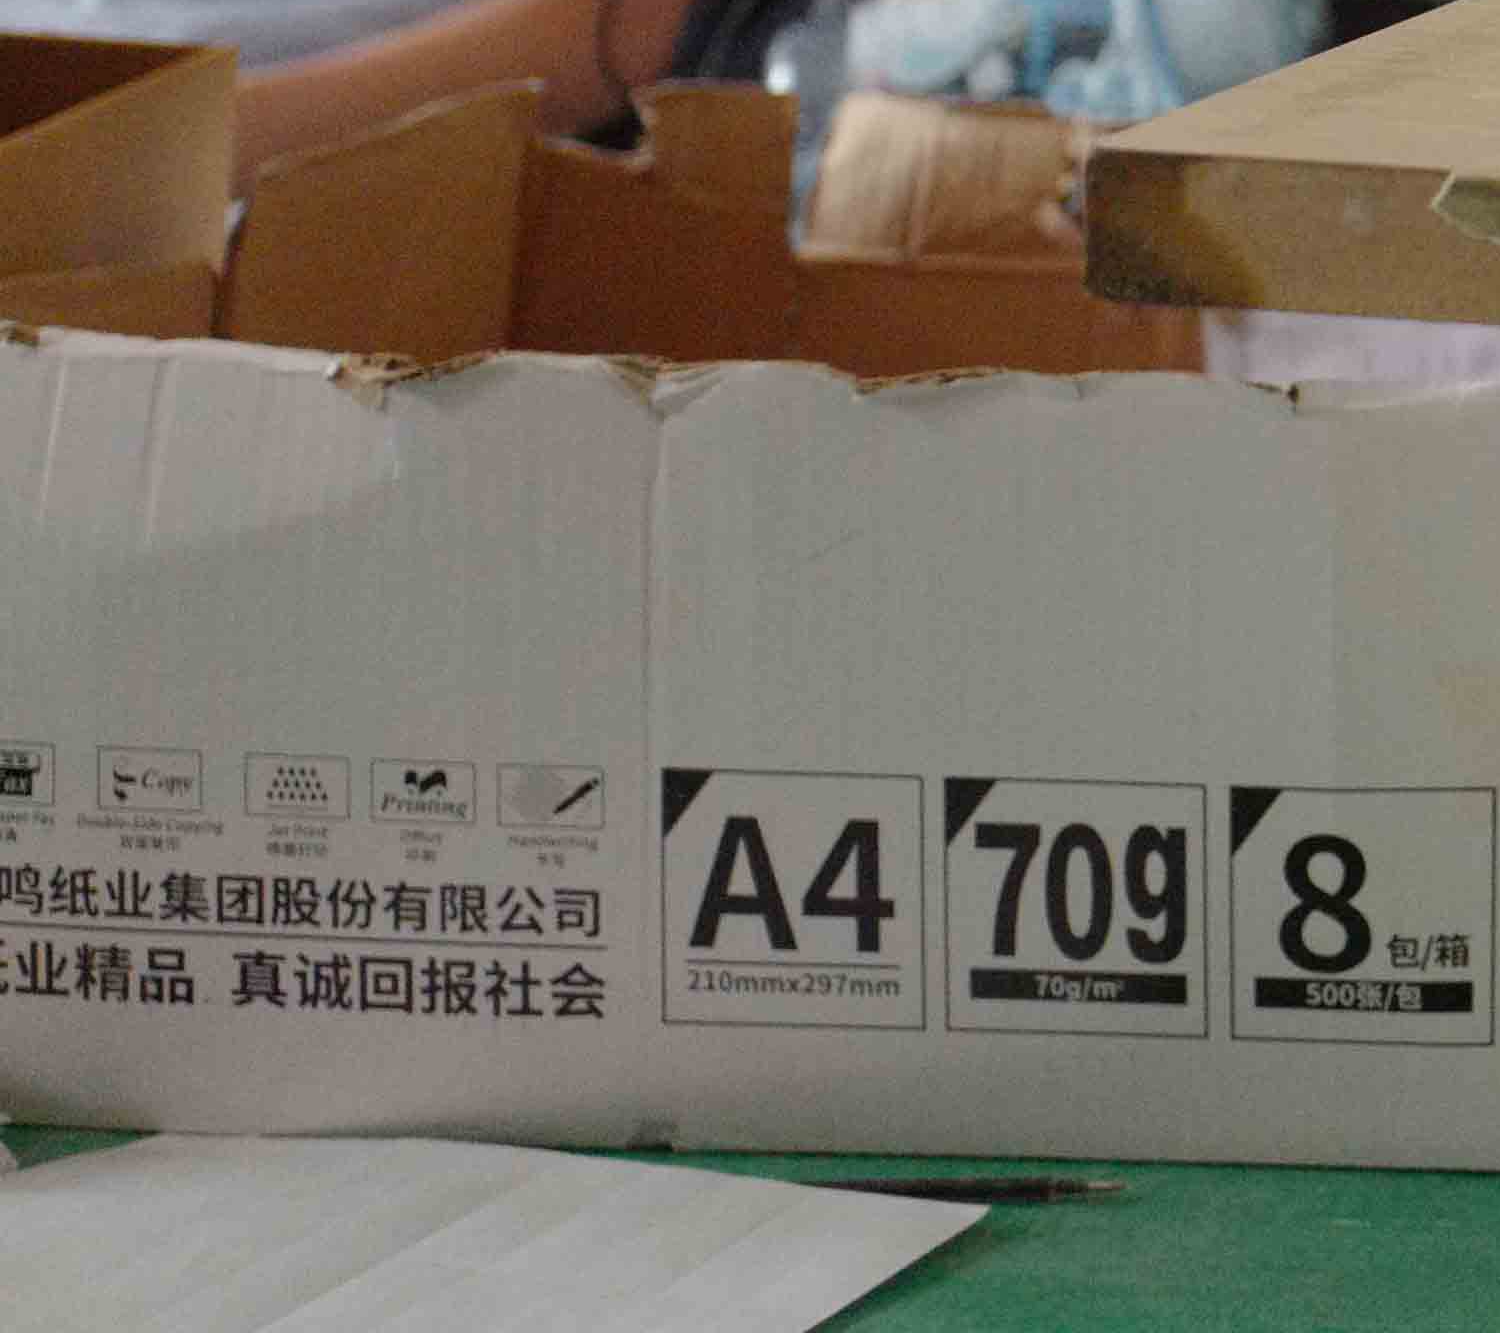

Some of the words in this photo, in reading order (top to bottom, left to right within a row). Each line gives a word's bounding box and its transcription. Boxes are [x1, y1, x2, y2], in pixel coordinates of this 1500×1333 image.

[381, 791, 468, 818] Printing
[0, 864, 601, 937] 鸣纸业集团股份有限公司
[689, 815, 895, 953] A4
[974, 822, 1187, 965] 70g
[1279, 833, 1372, 974] 8
[1386, 933, 1471, 970] 包/箱
[231, 949, 606, 1019] 真诚回报社会
[1305, 982, 1423, 1011] 500张/包
